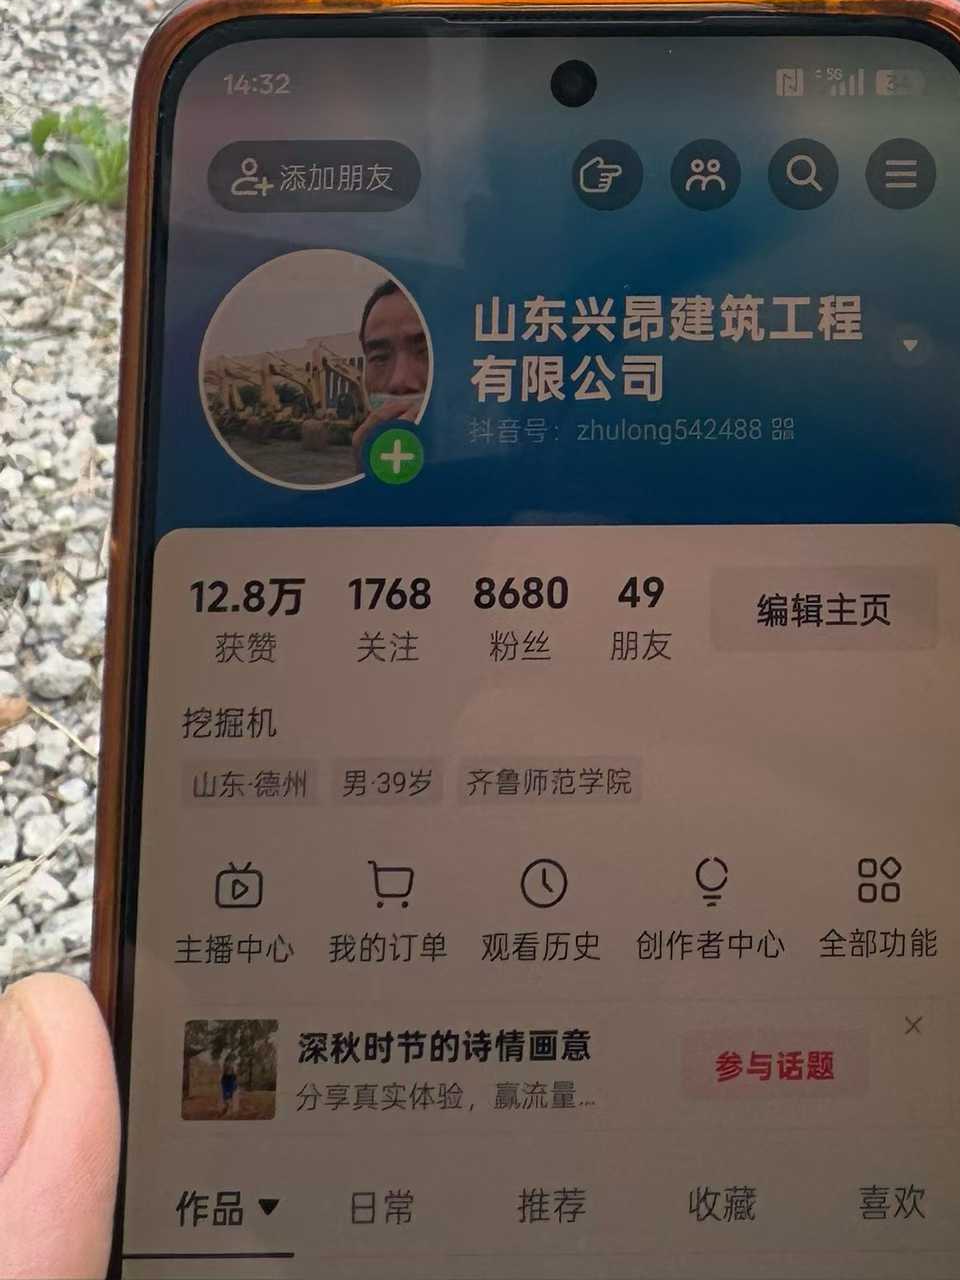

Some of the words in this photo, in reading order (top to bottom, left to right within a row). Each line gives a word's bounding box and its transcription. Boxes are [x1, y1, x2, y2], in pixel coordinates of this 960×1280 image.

[223, 73, 291, 95] 14:32
[280, 163, 393, 191] 添加朋友
[474, 294, 863, 343] 山东兴昂建筑工程
[470, 354, 664, 402] 有限公司
[576, 418, 763, 445] zhulong542488
[189, 578, 306, 616] 12.8万
[348, 577, 432, 611] 1768
[474, 576, 569, 610] 8680
[618, 576, 665, 609] 49
[756, 592, 891, 628] 编辑主页
[215, 632, 277, 663] 获赞
[357, 631, 419, 663] 关注
[489, 630, 551, 662] 粉丝
[610, 628, 672, 661] 朋友
[182, 706, 278, 739] 挖掘机
[465, 768, 633, 797] 齐鲁师范学院
[174, 933, 295, 965] 主播中心
[328, 932, 448, 963] 我的订单
[481, 930, 601, 962] 观看历史
[636, 928, 785, 960] 创作者中心
[819, 927, 938, 959] 全部功能
[297, 1029, 592, 1064] 深秋时节的诗情画意
[714, 1050, 835, 1082] 参与话题
[175, 1190, 244, 1227] 作品
[351, 1190, 414, 1225] 日常
[518, 1187, 586, 1223] 推荐
[689, 1186, 757, 1222] 收藏
[859, 1184, 926, 1220] 喜欢
